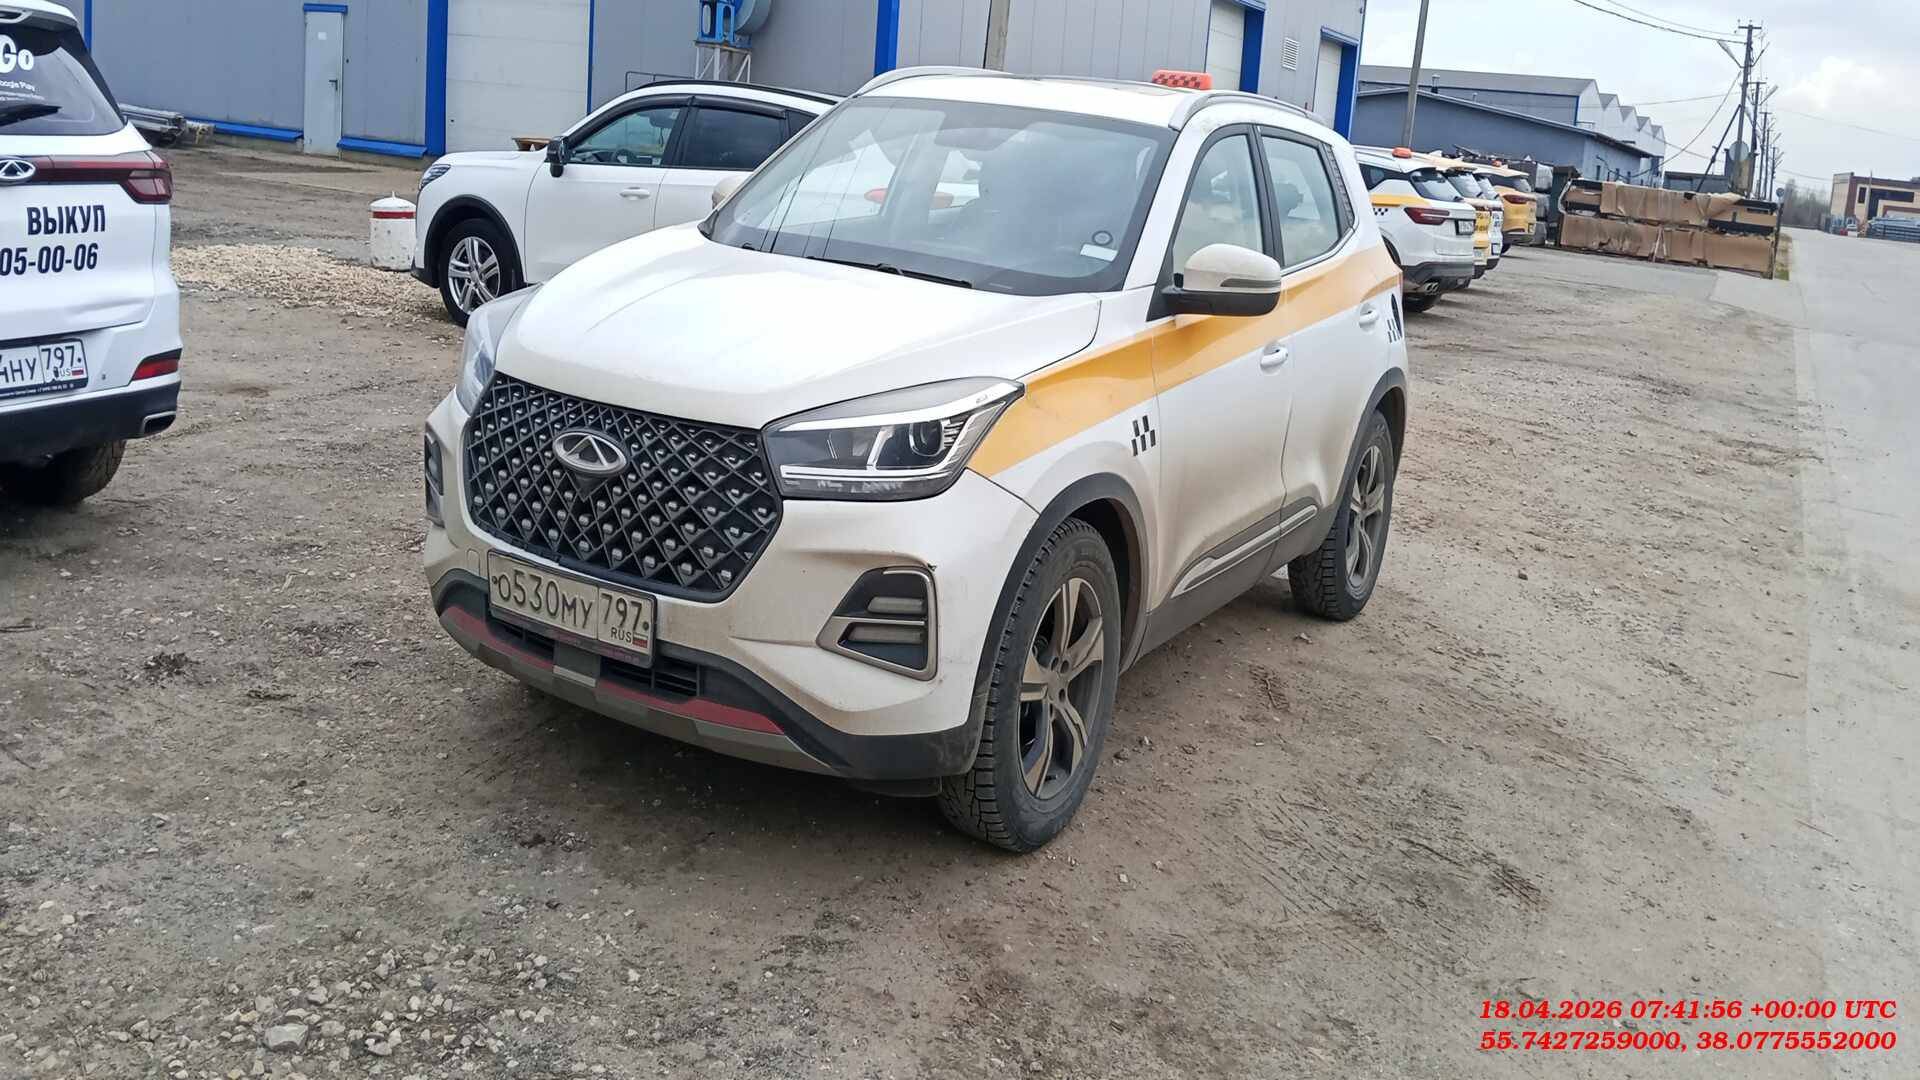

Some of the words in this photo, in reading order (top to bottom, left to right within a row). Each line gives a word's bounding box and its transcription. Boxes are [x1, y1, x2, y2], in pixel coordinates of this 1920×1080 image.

[27, 205, 105, 235] ВЫКУП
[41, 345, 74, 370] 797
[499, 569, 593, 628] О530МУ
[602, 593, 642, 631] 797
[611, 627, 632, 644] RUS
